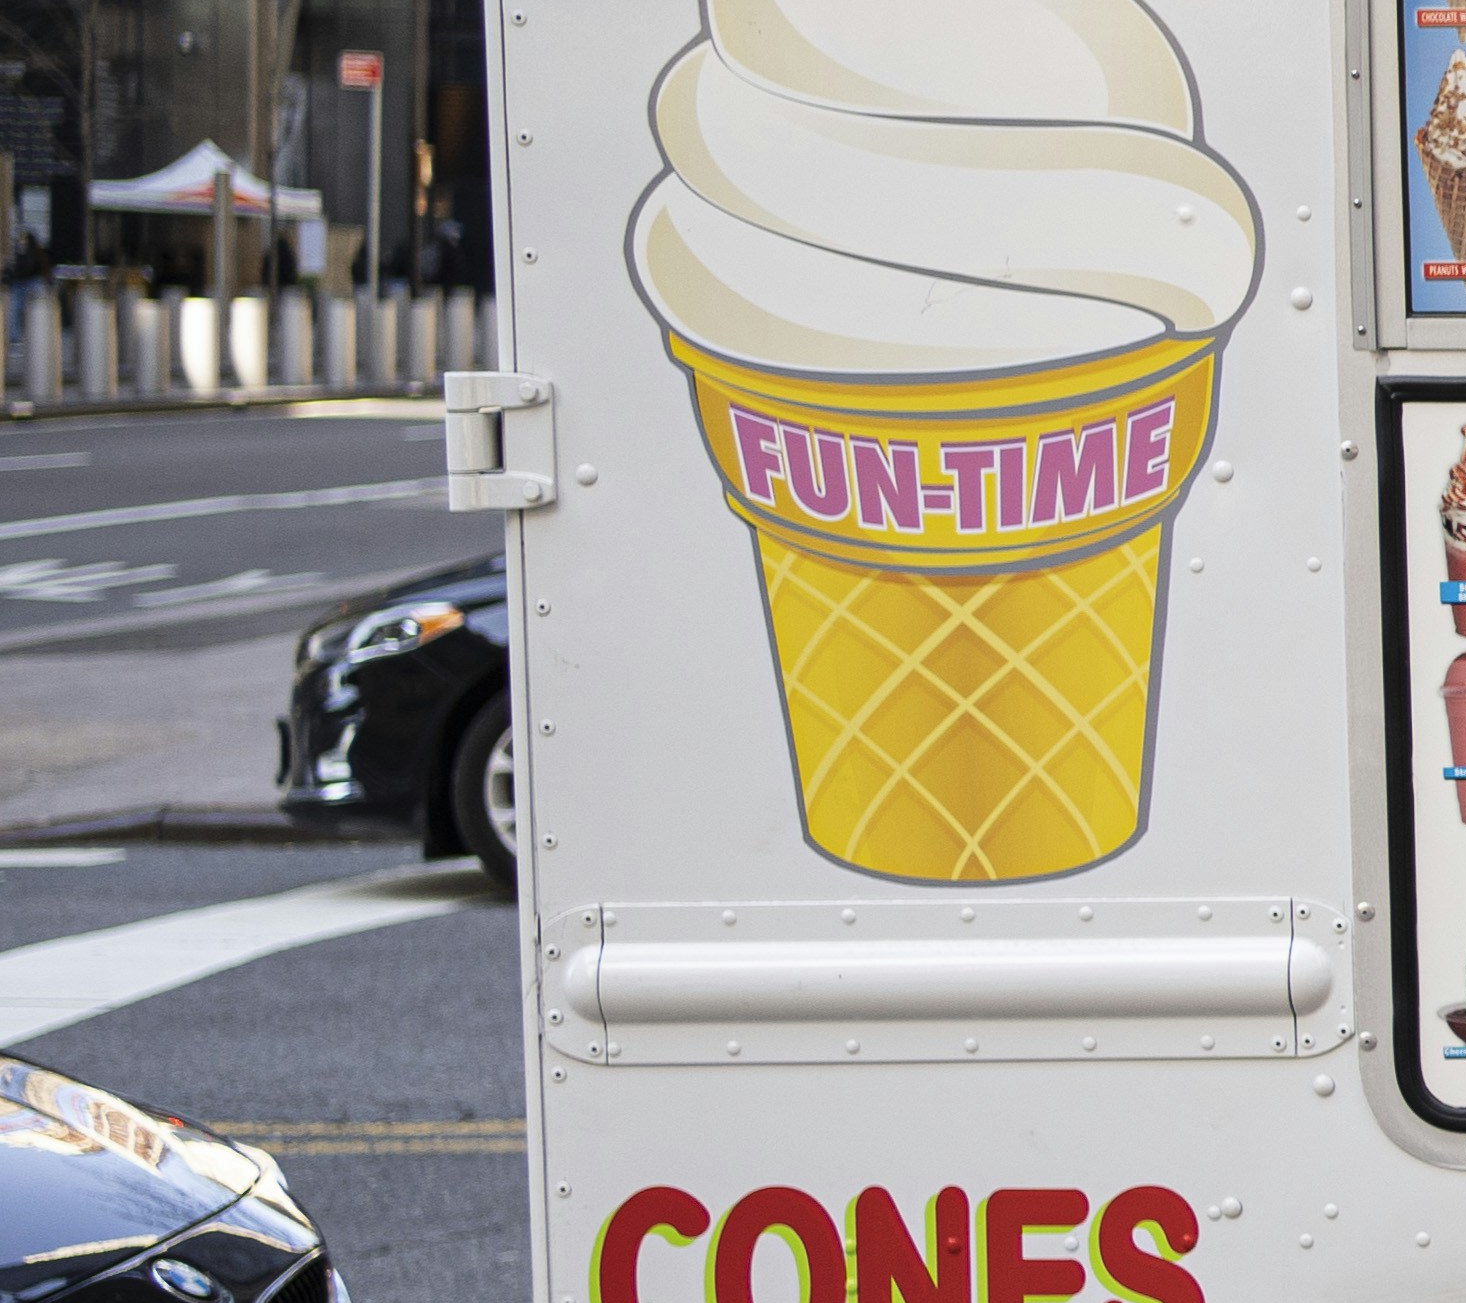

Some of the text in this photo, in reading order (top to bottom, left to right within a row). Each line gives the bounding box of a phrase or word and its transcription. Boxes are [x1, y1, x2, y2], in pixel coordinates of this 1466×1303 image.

[1421, 13, 1458, 23] CHOCOLATE
[1429, 266, 1458, 276] PEANUTS
[729, 396, 1175, 533] FUN-TIME
